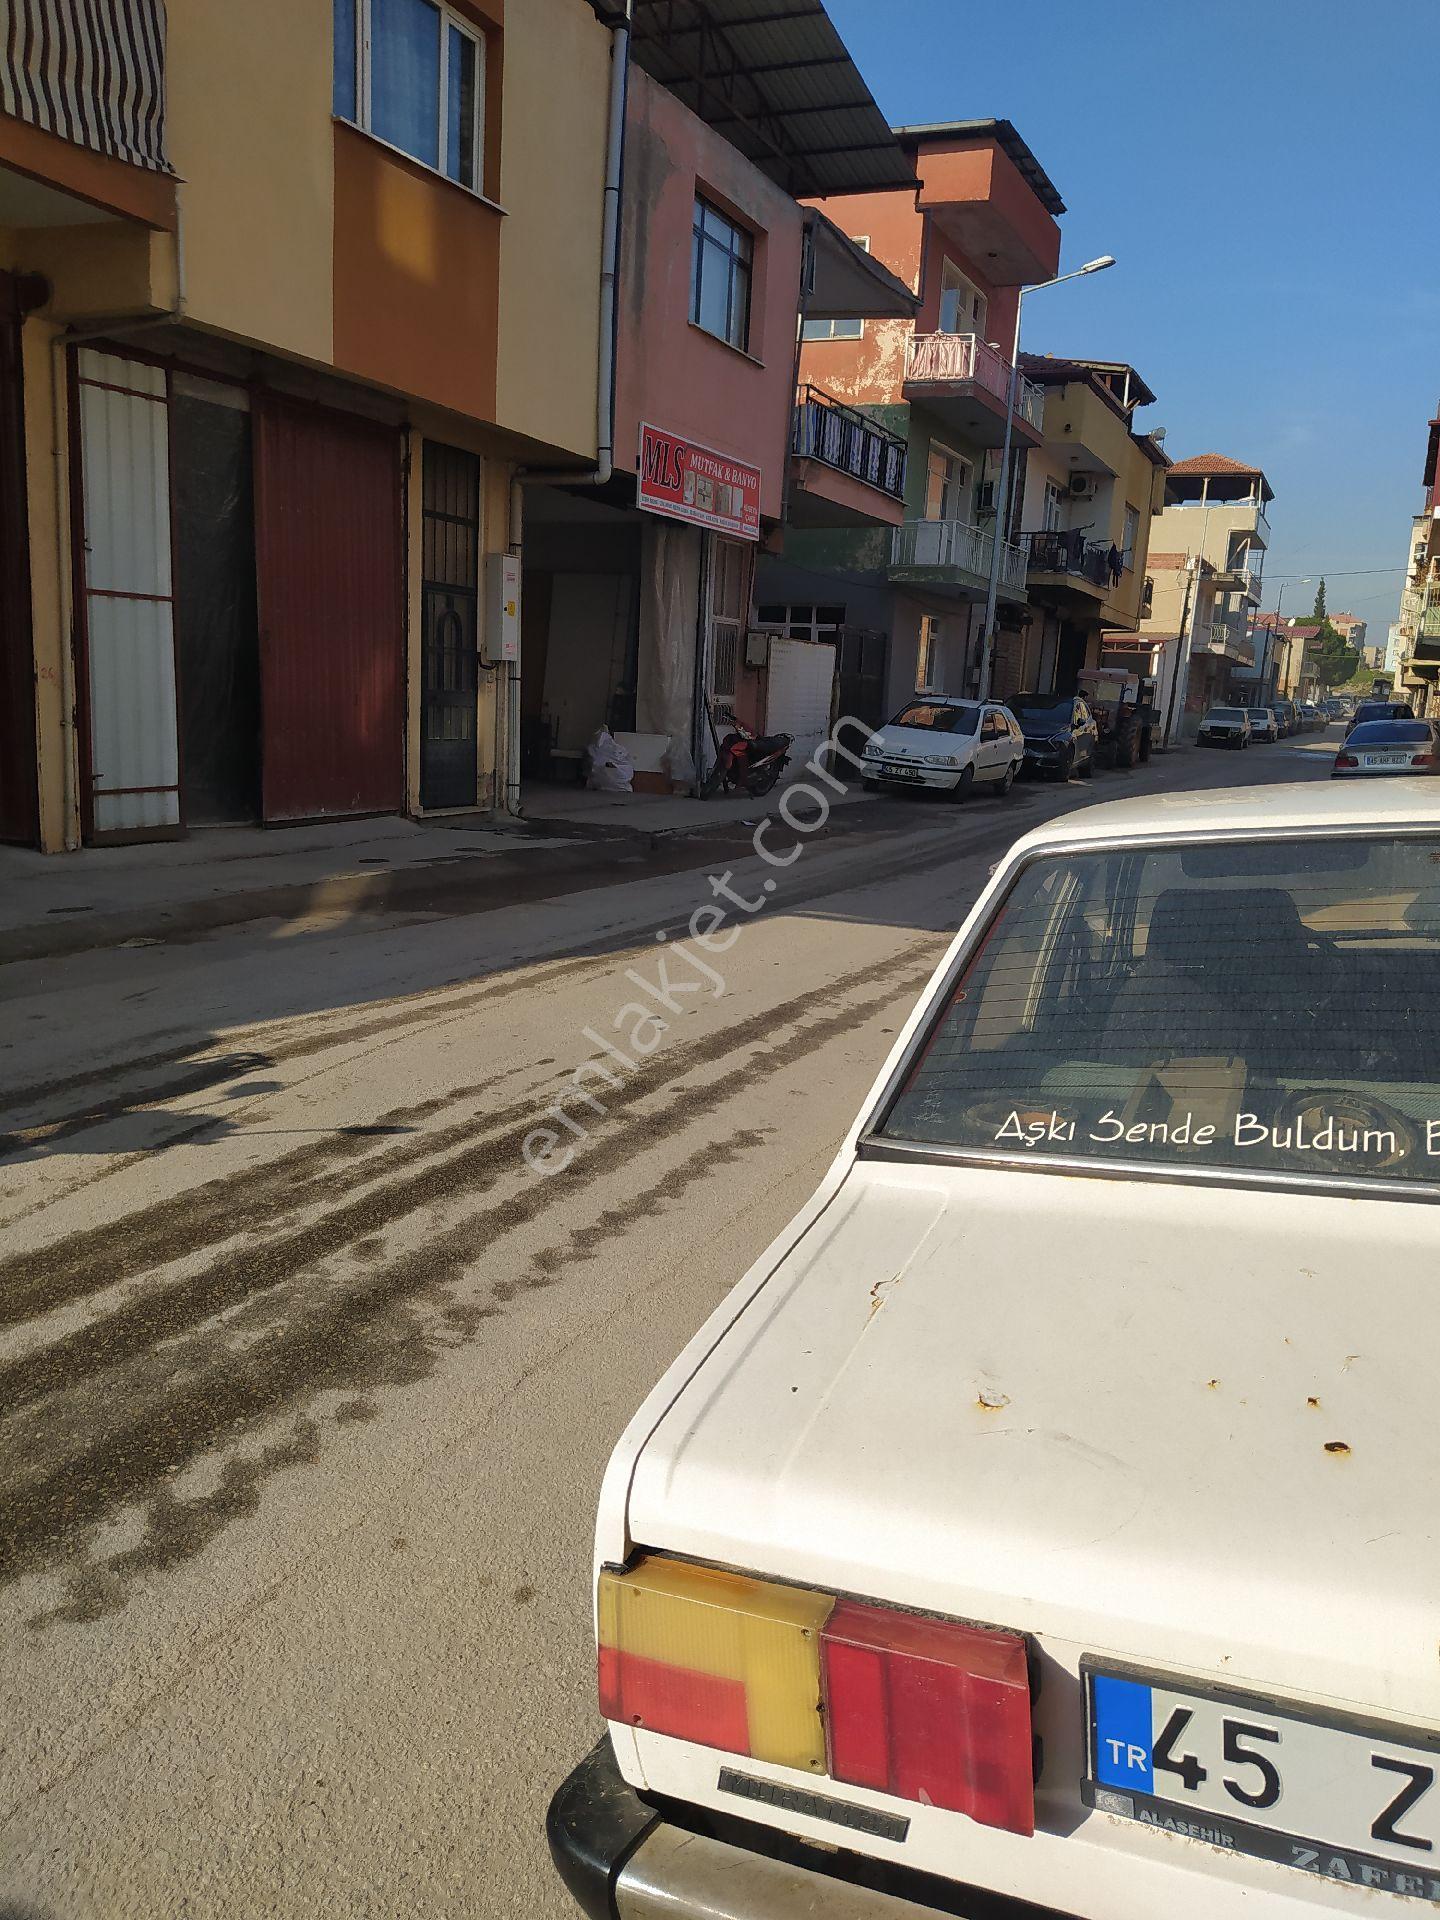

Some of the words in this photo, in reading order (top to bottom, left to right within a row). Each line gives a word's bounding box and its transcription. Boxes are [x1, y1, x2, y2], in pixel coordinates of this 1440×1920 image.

[641, 435, 685, 491] MLS
[690, 453, 724, 479] MUTFAK
[724, 467, 731, 481] &
[731, 468, 757, 490] BANYO
[995, 1110, 1076, 1147] Aşkı
[1089, 1110, 1216, 1145] Sende
[1234, 1113, 1405, 1156] Buldum,
[1104, 1738, 1148, 1772] TR
[1151, 1707, 1281, 1809] 45
[1370, 1753, 1433, 1851] Z
